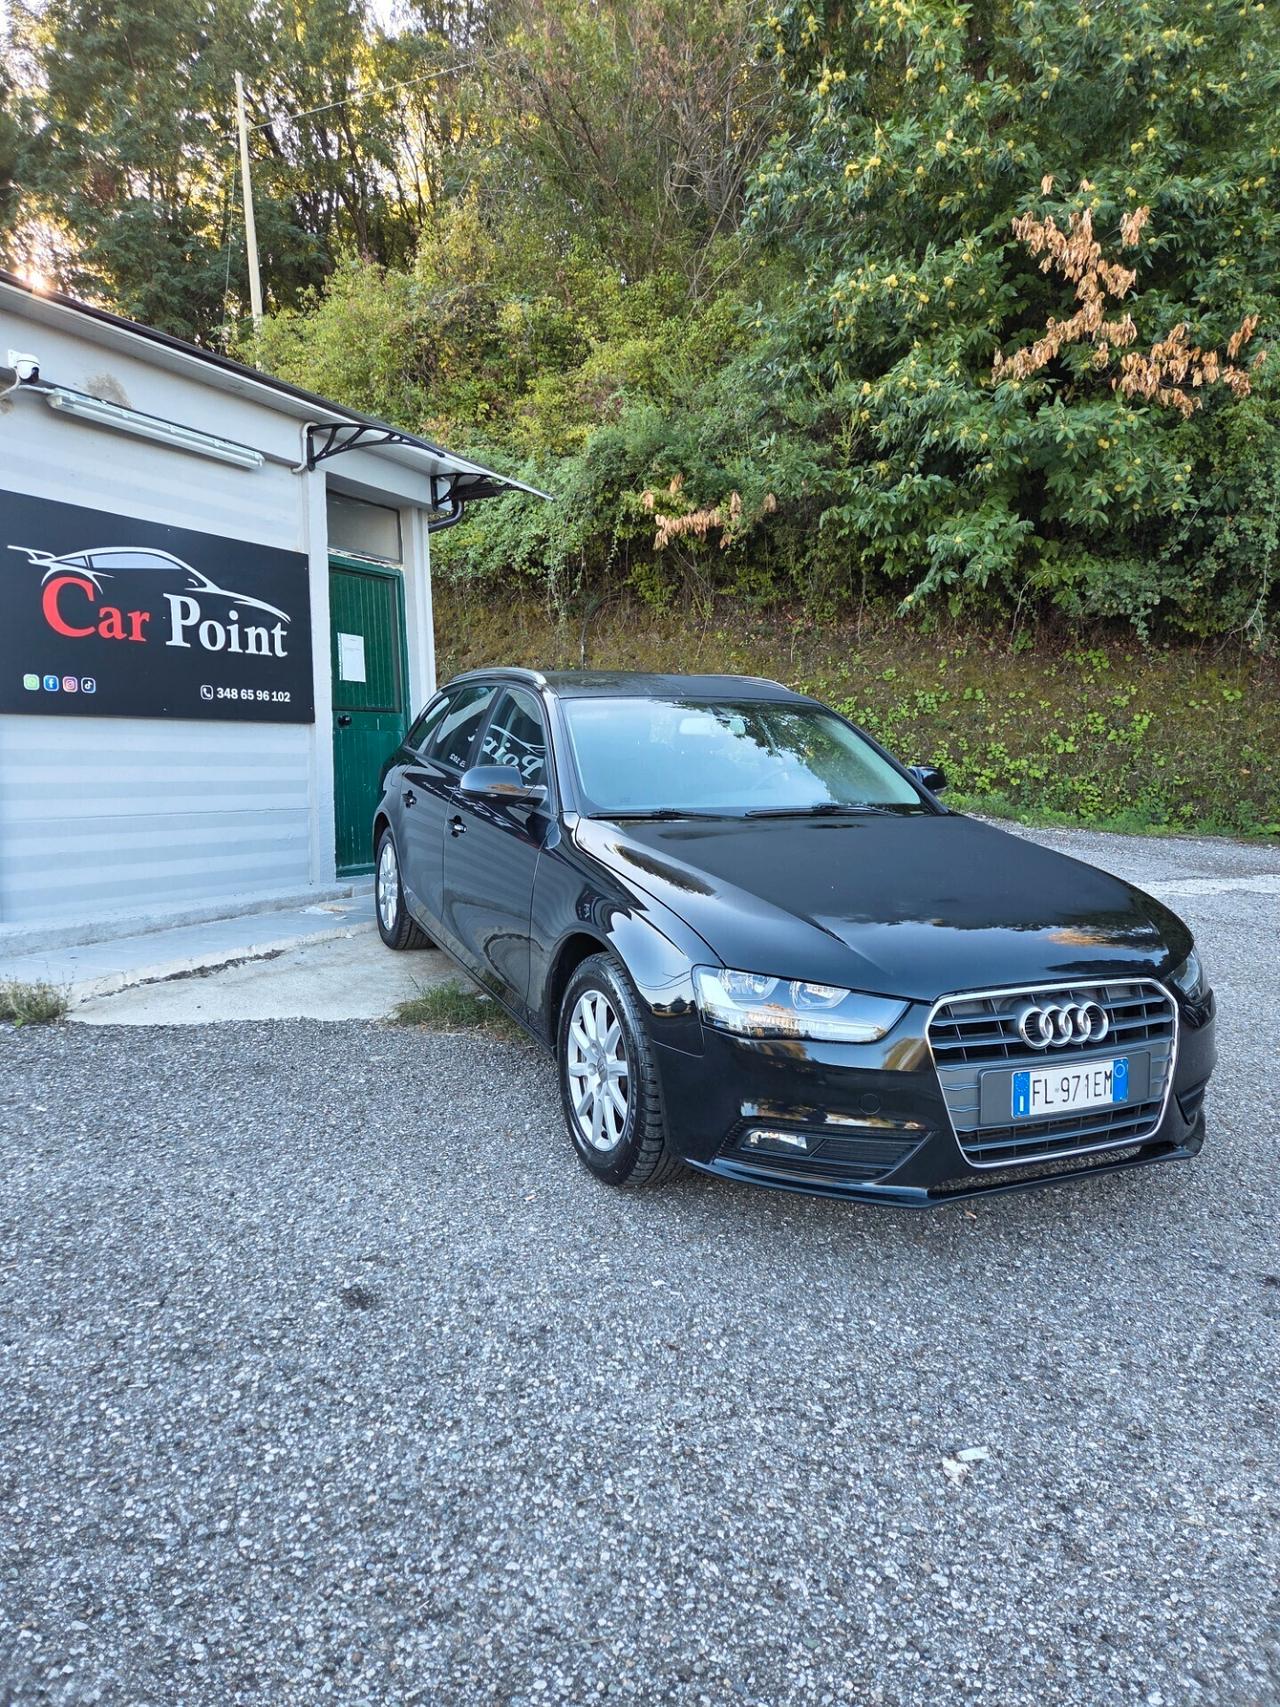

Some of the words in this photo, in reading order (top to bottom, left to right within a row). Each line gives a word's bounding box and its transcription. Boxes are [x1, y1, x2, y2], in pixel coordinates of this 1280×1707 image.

[42, 576, 150, 642] Car
[163, 592, 289, 658] Point
[216, 687, 238, 699] 348
[240, 689, 254, 700] 65
[256, 690, 270, 701] 96
[271, 691, 291, 702] 102
